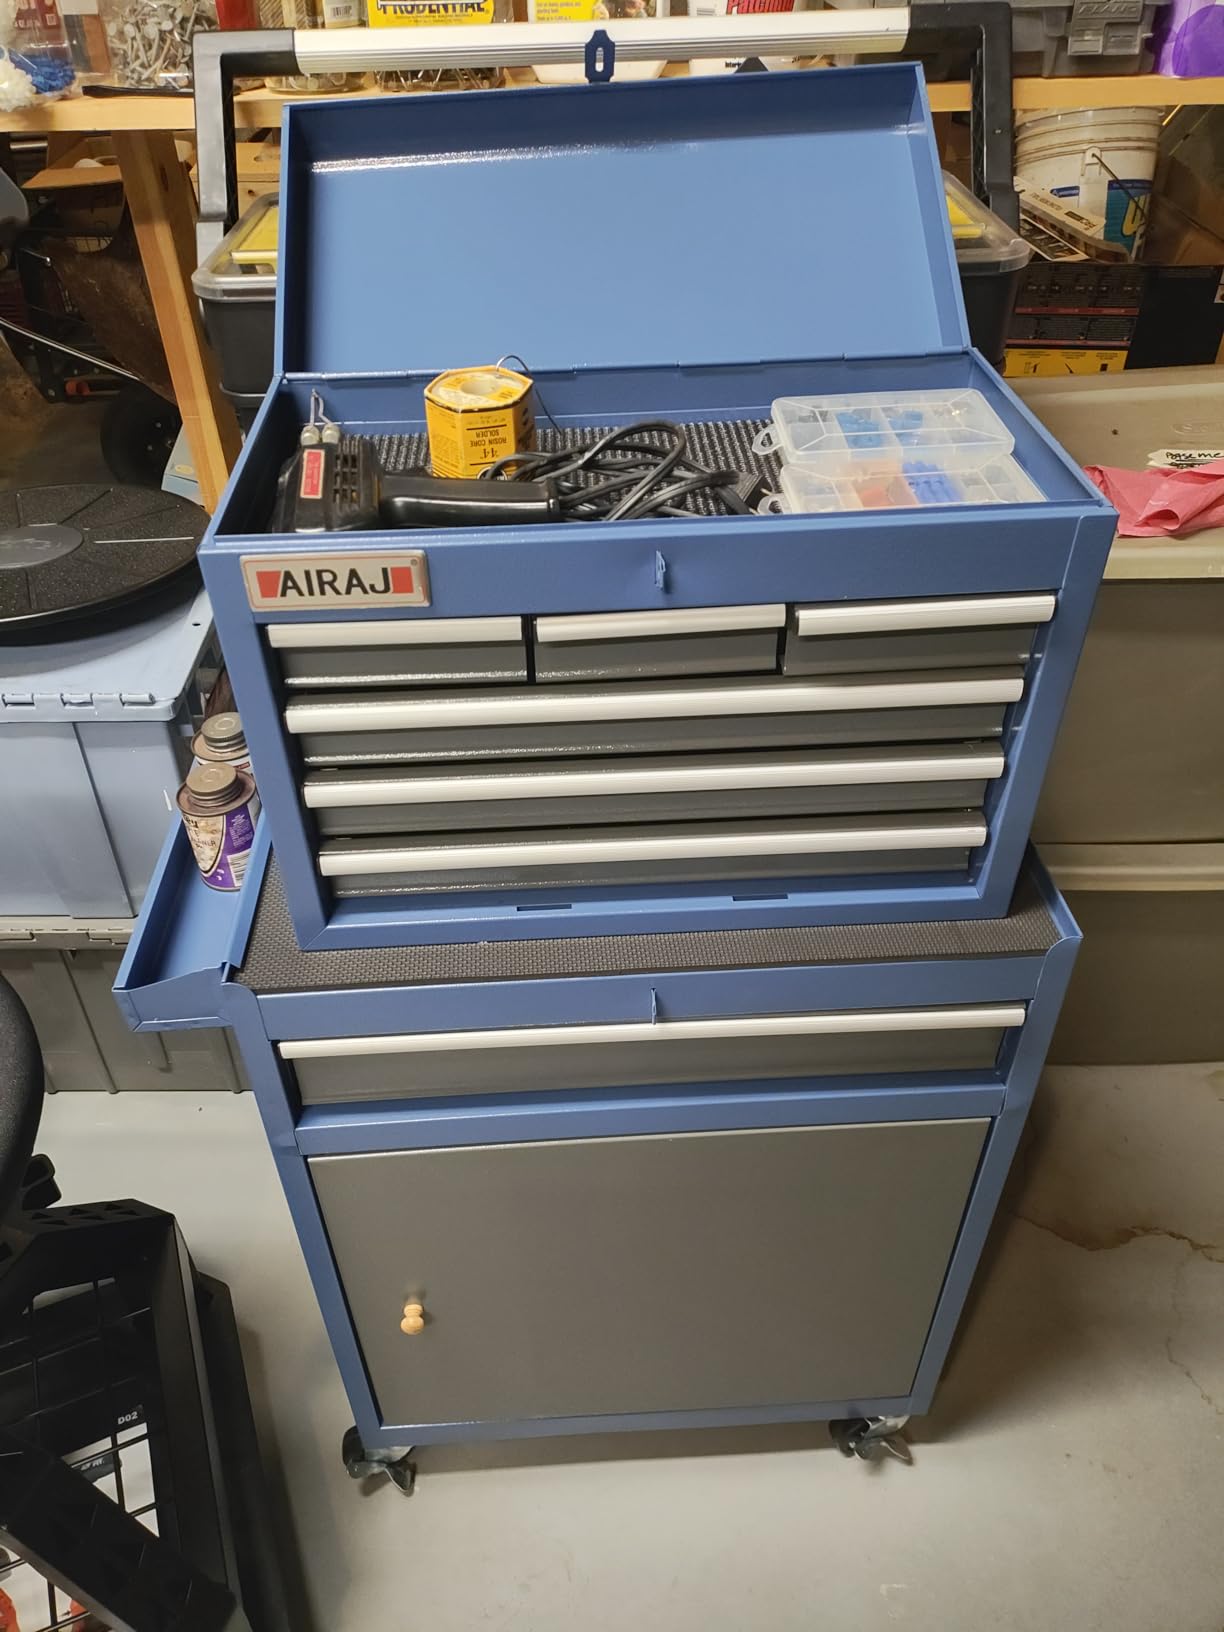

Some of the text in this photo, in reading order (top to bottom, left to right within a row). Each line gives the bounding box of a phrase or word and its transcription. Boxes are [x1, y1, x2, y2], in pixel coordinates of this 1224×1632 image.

[475, 429, 499, 438] SOLDER
[470, 437, 507, 448] ROSIN CORE
[280, 567, 392, 598] AIRAJ
